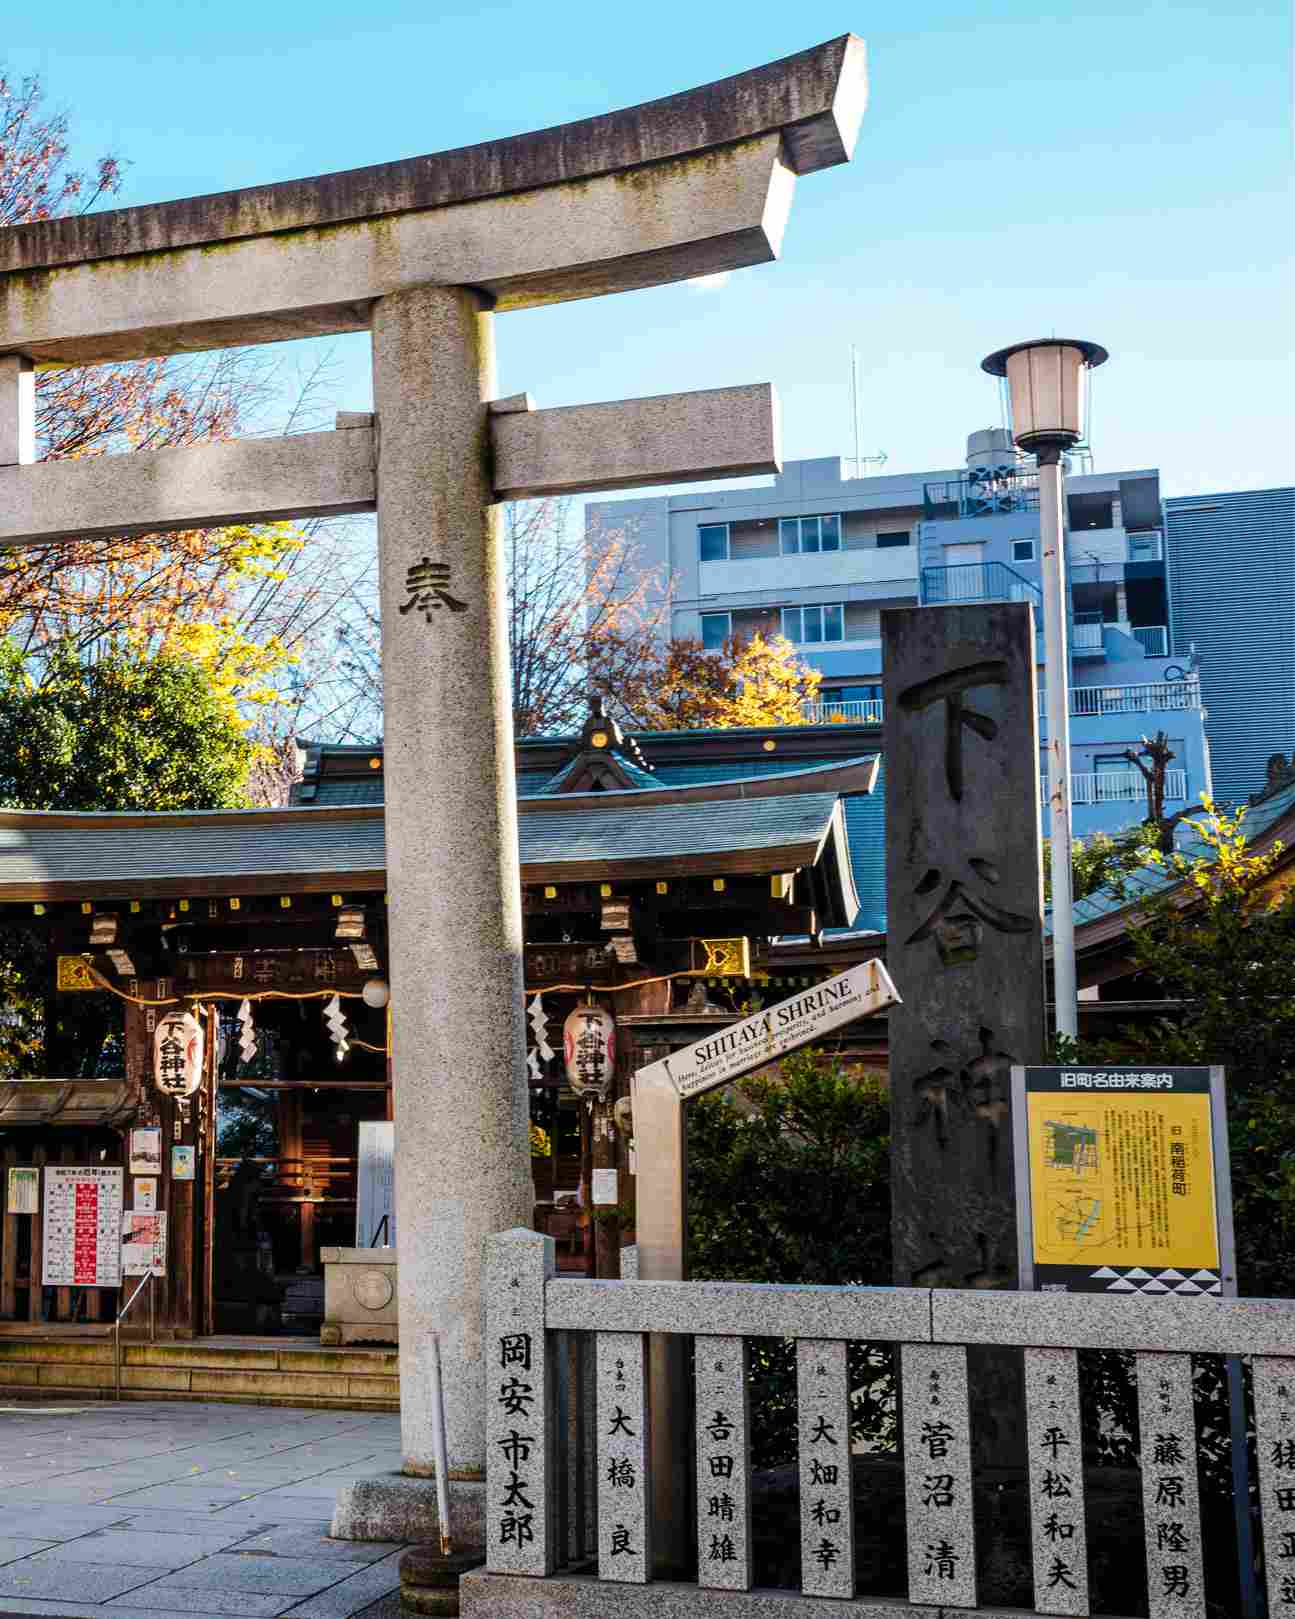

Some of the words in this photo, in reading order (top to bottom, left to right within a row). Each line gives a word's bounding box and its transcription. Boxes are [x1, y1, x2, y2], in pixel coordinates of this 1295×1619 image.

[398, 556, 468, 624] 奉
[160, 1021, 187, 1089] 下谷神社
[576, 1013, 605, 1086] 下谷神社
[694, 1010, 772, 1066] SHITAYA
[777, 976, 853, 1028] SHRINE
[1060, 1072, 1174, 1089] 旧町名由来案内
[497, 1333, 536, 1550] 岡安市太郎
[607, 1406, 638, 1557] 大橋良
[808, 1415, 842, 1572] 大畑和幸
[920, 1420, 961, 1581] 菅沼清
[1039, 1426, 1077, 1590] 平松和夫
[1152, 1432, 1191, 1600] 藤原隆男
